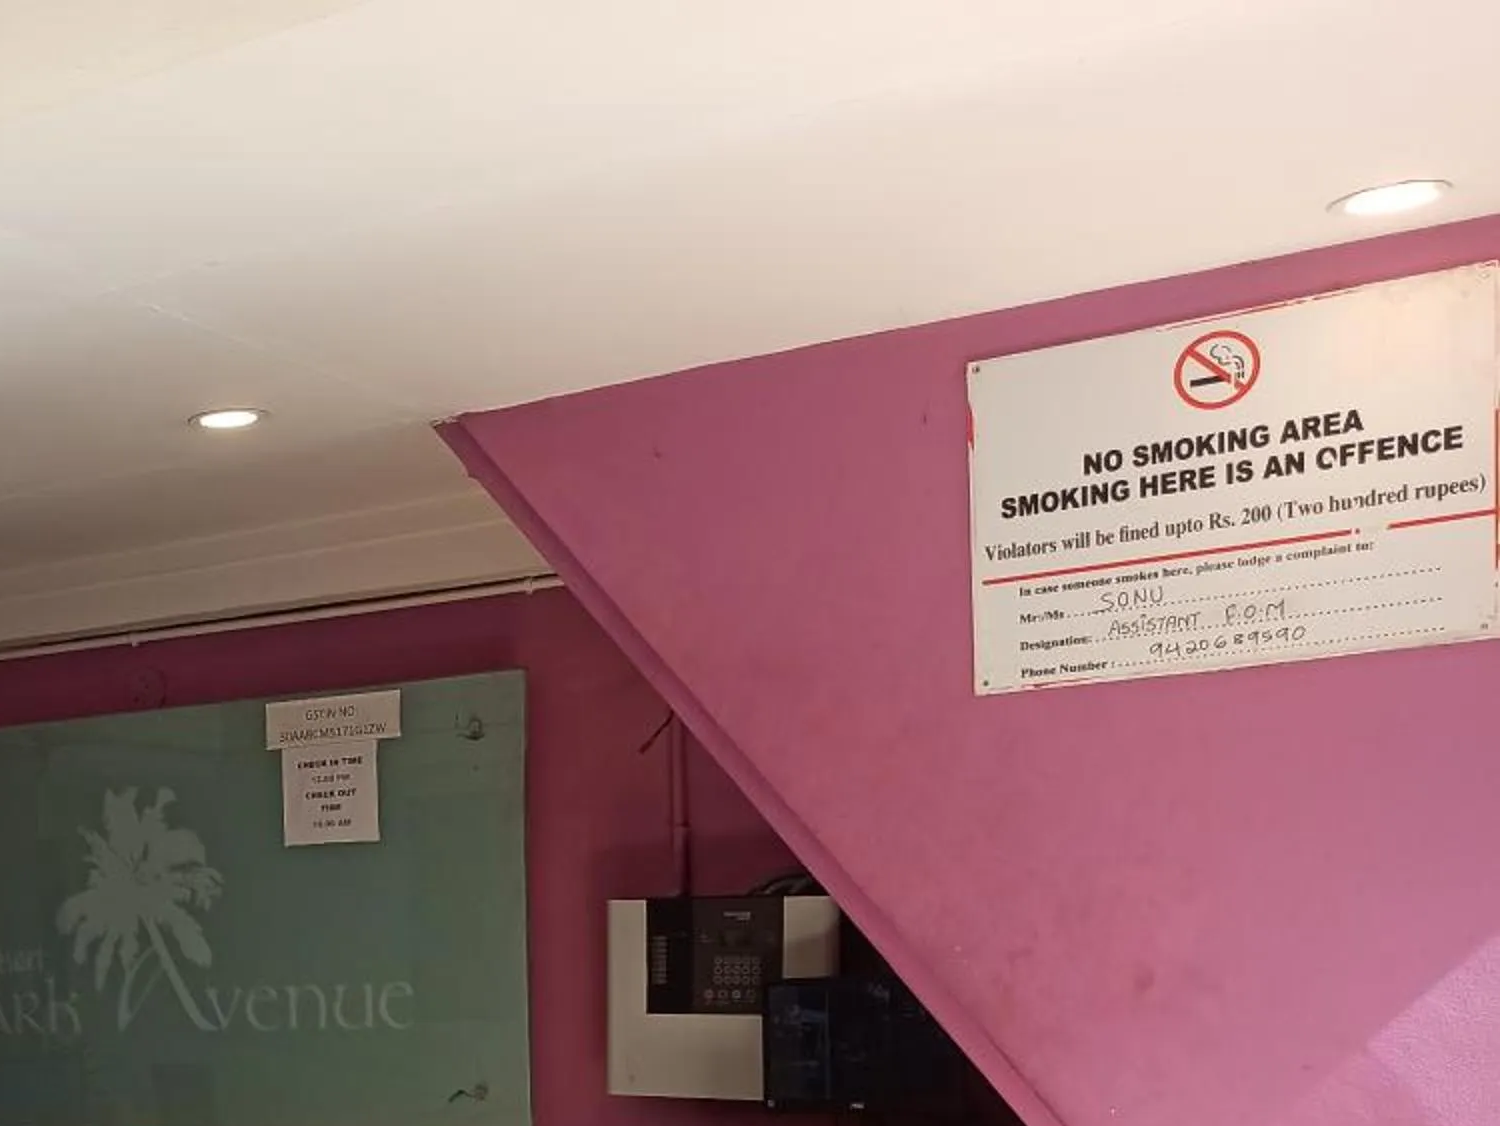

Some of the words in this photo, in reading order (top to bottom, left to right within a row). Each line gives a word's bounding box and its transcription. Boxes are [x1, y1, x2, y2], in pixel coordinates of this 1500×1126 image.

[1000, 479, 1131, 519] SMOKING
[1139, 465, 1216, 498] HERE
[1225, 459, 1254, 485] IS
[1263, 451, 1305, 480] AN
[1315, 425, 1463, 470] OFFENCE
[1083, 449, 1123, 476] NO
[1132, 424, 1270, 468] SMOKING
[1279, 409, 1364, 444] AREA
[985, 539, 1058, 562] Violators
[1061, 531, 1091, 550] will
[1095, 528, 1116, 546] be
[1119, 521, 1160, 543] fined
[1164, 517, 1204, 539] upto
[1208, 511, 1236, 531] Rs.
[1240, 505, 1272, 526] 200
[1277, 499, 1324, 522] (Two
[1328, 483, 1409, 513] hundred
[1414, 472, 1487, 502] rupees)
[1019, 586, 1032, 597] In
[1034, 584, 1060, 595] case
[1061, 576, 1113, 592] someone
[1115, 571, 1160, 584] smokes
[1195, 560, 1236, 576] please
[1237, 553, 1271, 568] lodge
[1285, 542, 1352, 562] complaint
[1099, 585, 1164, 613] SONU
[1020, 666, 1057, 679] Phone
[1059, 659, 1109, 674] Number
